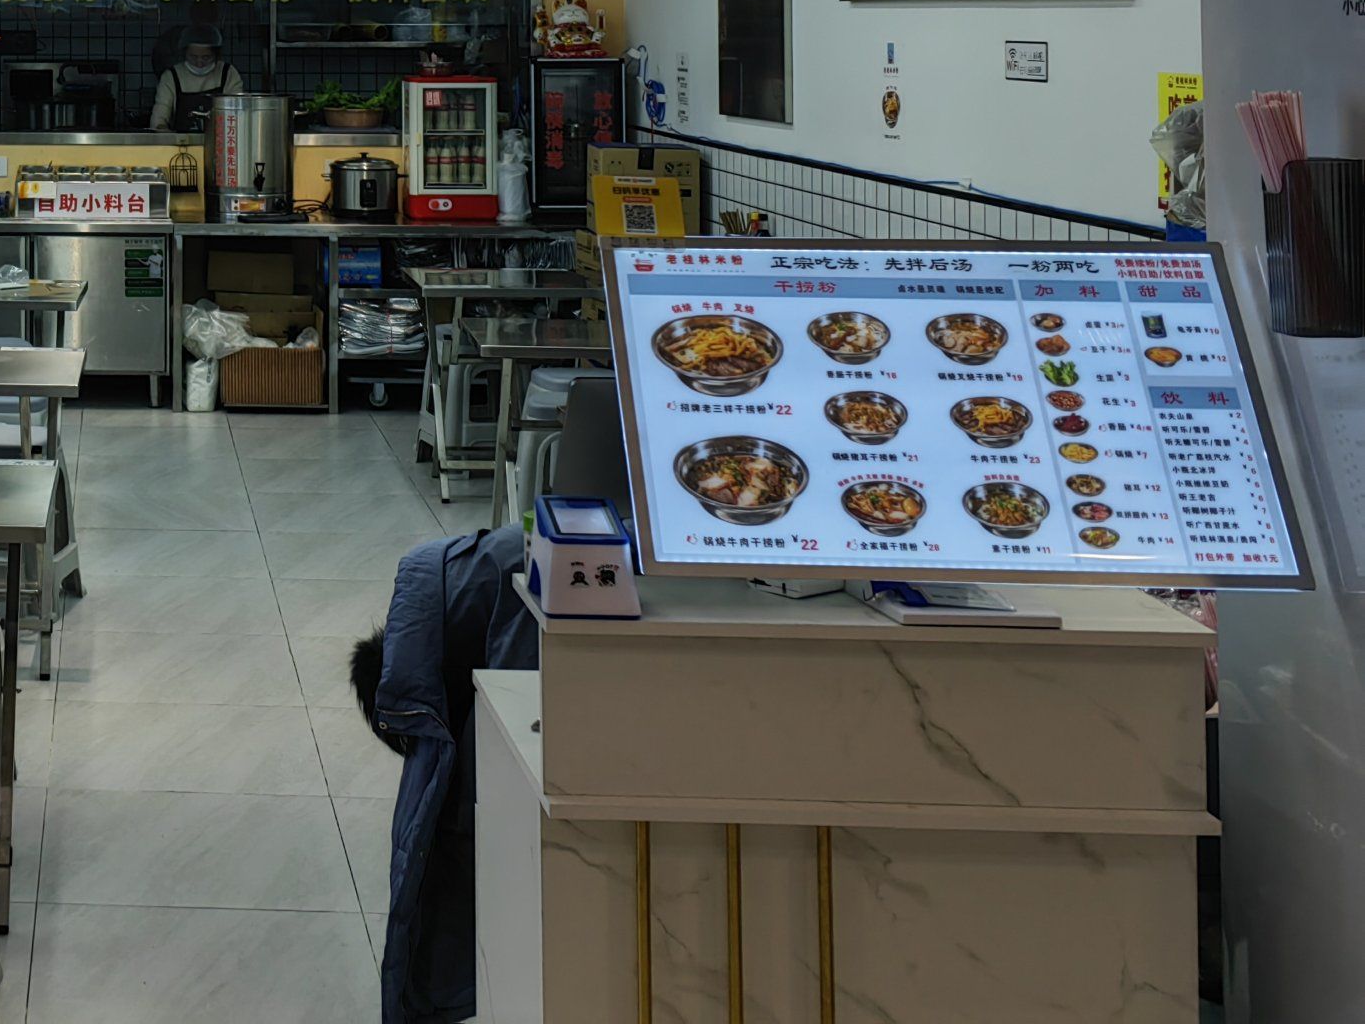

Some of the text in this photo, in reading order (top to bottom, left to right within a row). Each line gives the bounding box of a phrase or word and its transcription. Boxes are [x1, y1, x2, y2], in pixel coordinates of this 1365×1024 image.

[38, 193, 147, 214] 自助小料台
[666, 254, 744, 266] 老桂林米粉
[885, 257, 973, 272] 先拌后汤
[1008, 259, 1100, 274] 一粉两吃
[773, 280, 838, 294] 干捞粉
[1035, 284, 1101, 299] 加料
[1138, 284, 1202, 299] 甜品
[1161, 391, 1230, 406] 饮料
[680, 402, 793, 416] 招牌老三样干捞粉 ¥22
[970, 454, 1018, 464] 牛肉干捞粉
[703, 534, 819, 551] 锅烧牛肉干捞粉 ¥22
[859, 540, 919, 552] 全家福干捞粉
